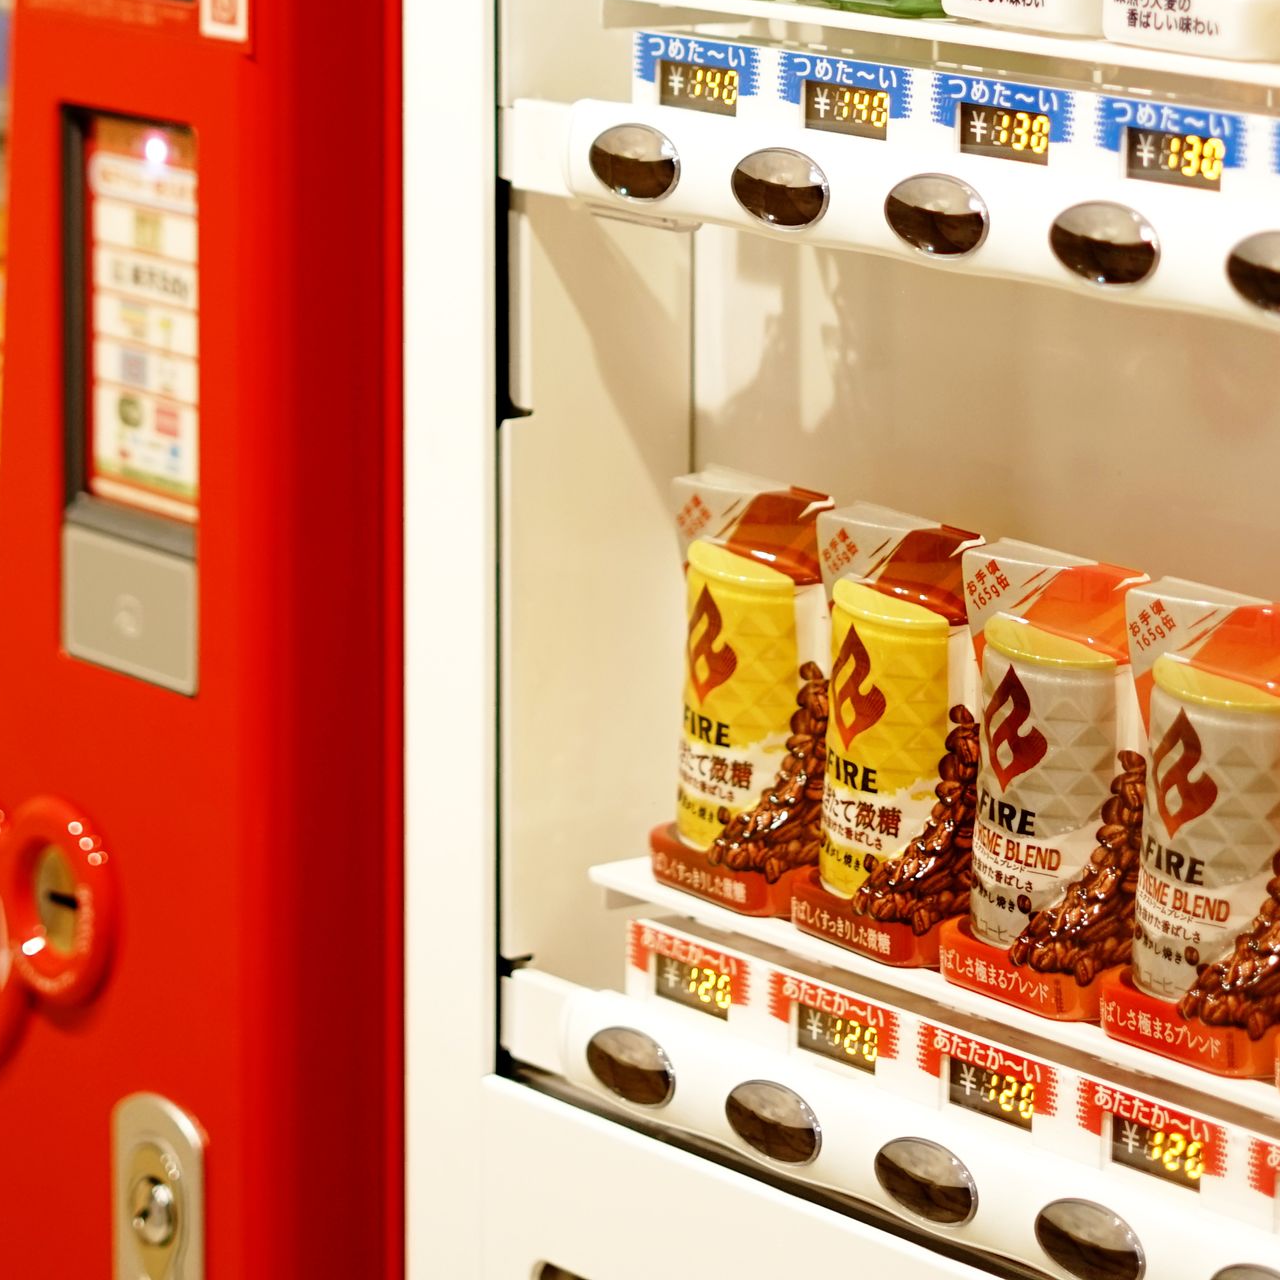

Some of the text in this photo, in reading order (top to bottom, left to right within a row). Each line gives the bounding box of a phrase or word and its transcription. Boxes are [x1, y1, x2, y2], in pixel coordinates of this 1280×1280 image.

[1126, 9, 1220, 37] 香ばしい味わい
[668, 66, 738, 105] ¥140
[813, 86, 890, 128] ¥140
[969, 111, 1051, 154] ¥130
[1137, 133, 1226, 180] ¥130
[684, 705, 731, 748] FIRE
[828, 750, 879, 794] FIRE
[979, 791, 1036, 837] FIRE
[1004, 840, 1062, 872] BLEND
[1145, 837, 1206, 886] FIRE
[1173, 888, 1231, 923] BLEND
[663, 959, 732, 1010] ¥120
[806, 1011, 879, 1063] ¥120
[960, 1065, 1035, 1120] ¥120
[1121, 1122, 1205, 1181] ¥120
